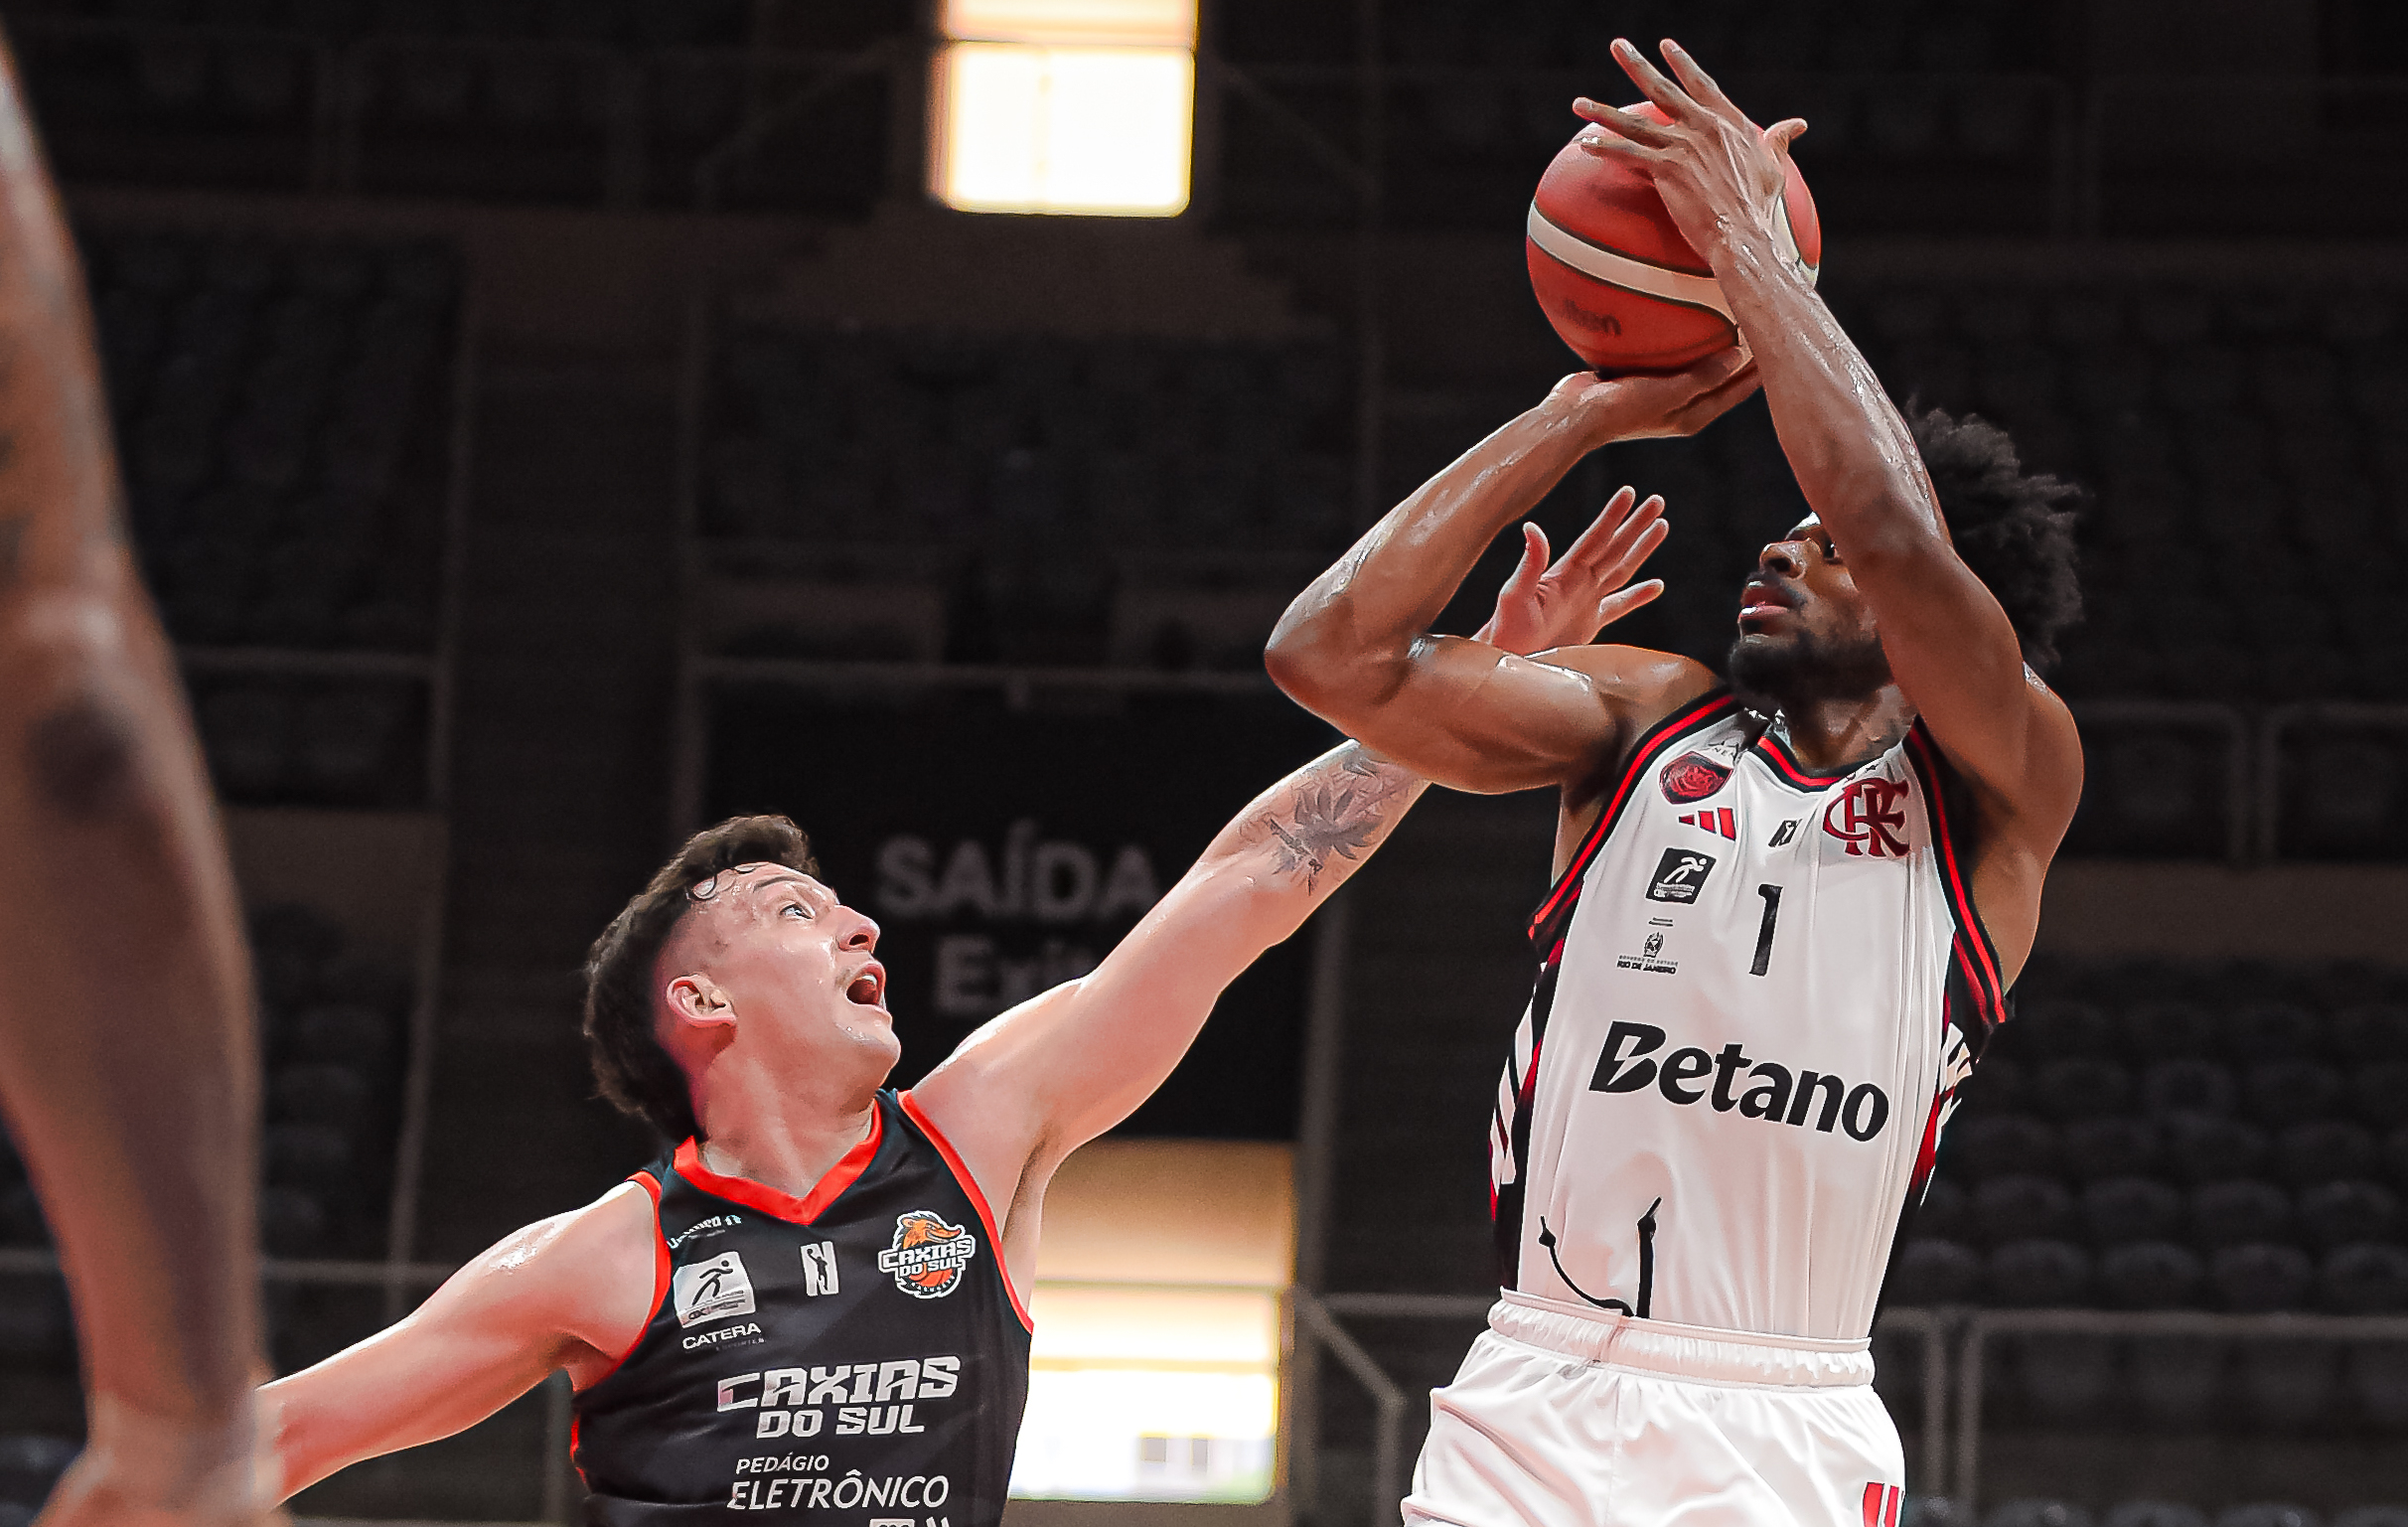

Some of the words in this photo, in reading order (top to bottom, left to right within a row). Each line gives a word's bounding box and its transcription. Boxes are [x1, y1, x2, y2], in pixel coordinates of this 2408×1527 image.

[876, 817, 1162, 920] SAÍDA
[1749, 883, 1783, 976] 1
[1588, 1020, 1889, 1143] Betano
[882, 1238, 972, 1269] CAXIAS
[899, 1263, 923, 1277] DO
[928, 1256, 963, 1272] SUL
[682, 1322, 762, 1350] CATERA
[716, 1355, 962, 1413] CAXIAS
[756, 1409, 824, 1440] DO
[835, 1404, 926, 1436] SUL
[735, 1451, 829, 1474] PEDÁGIO
[726, 1468, 950, 1510] ELETRÔNICO
